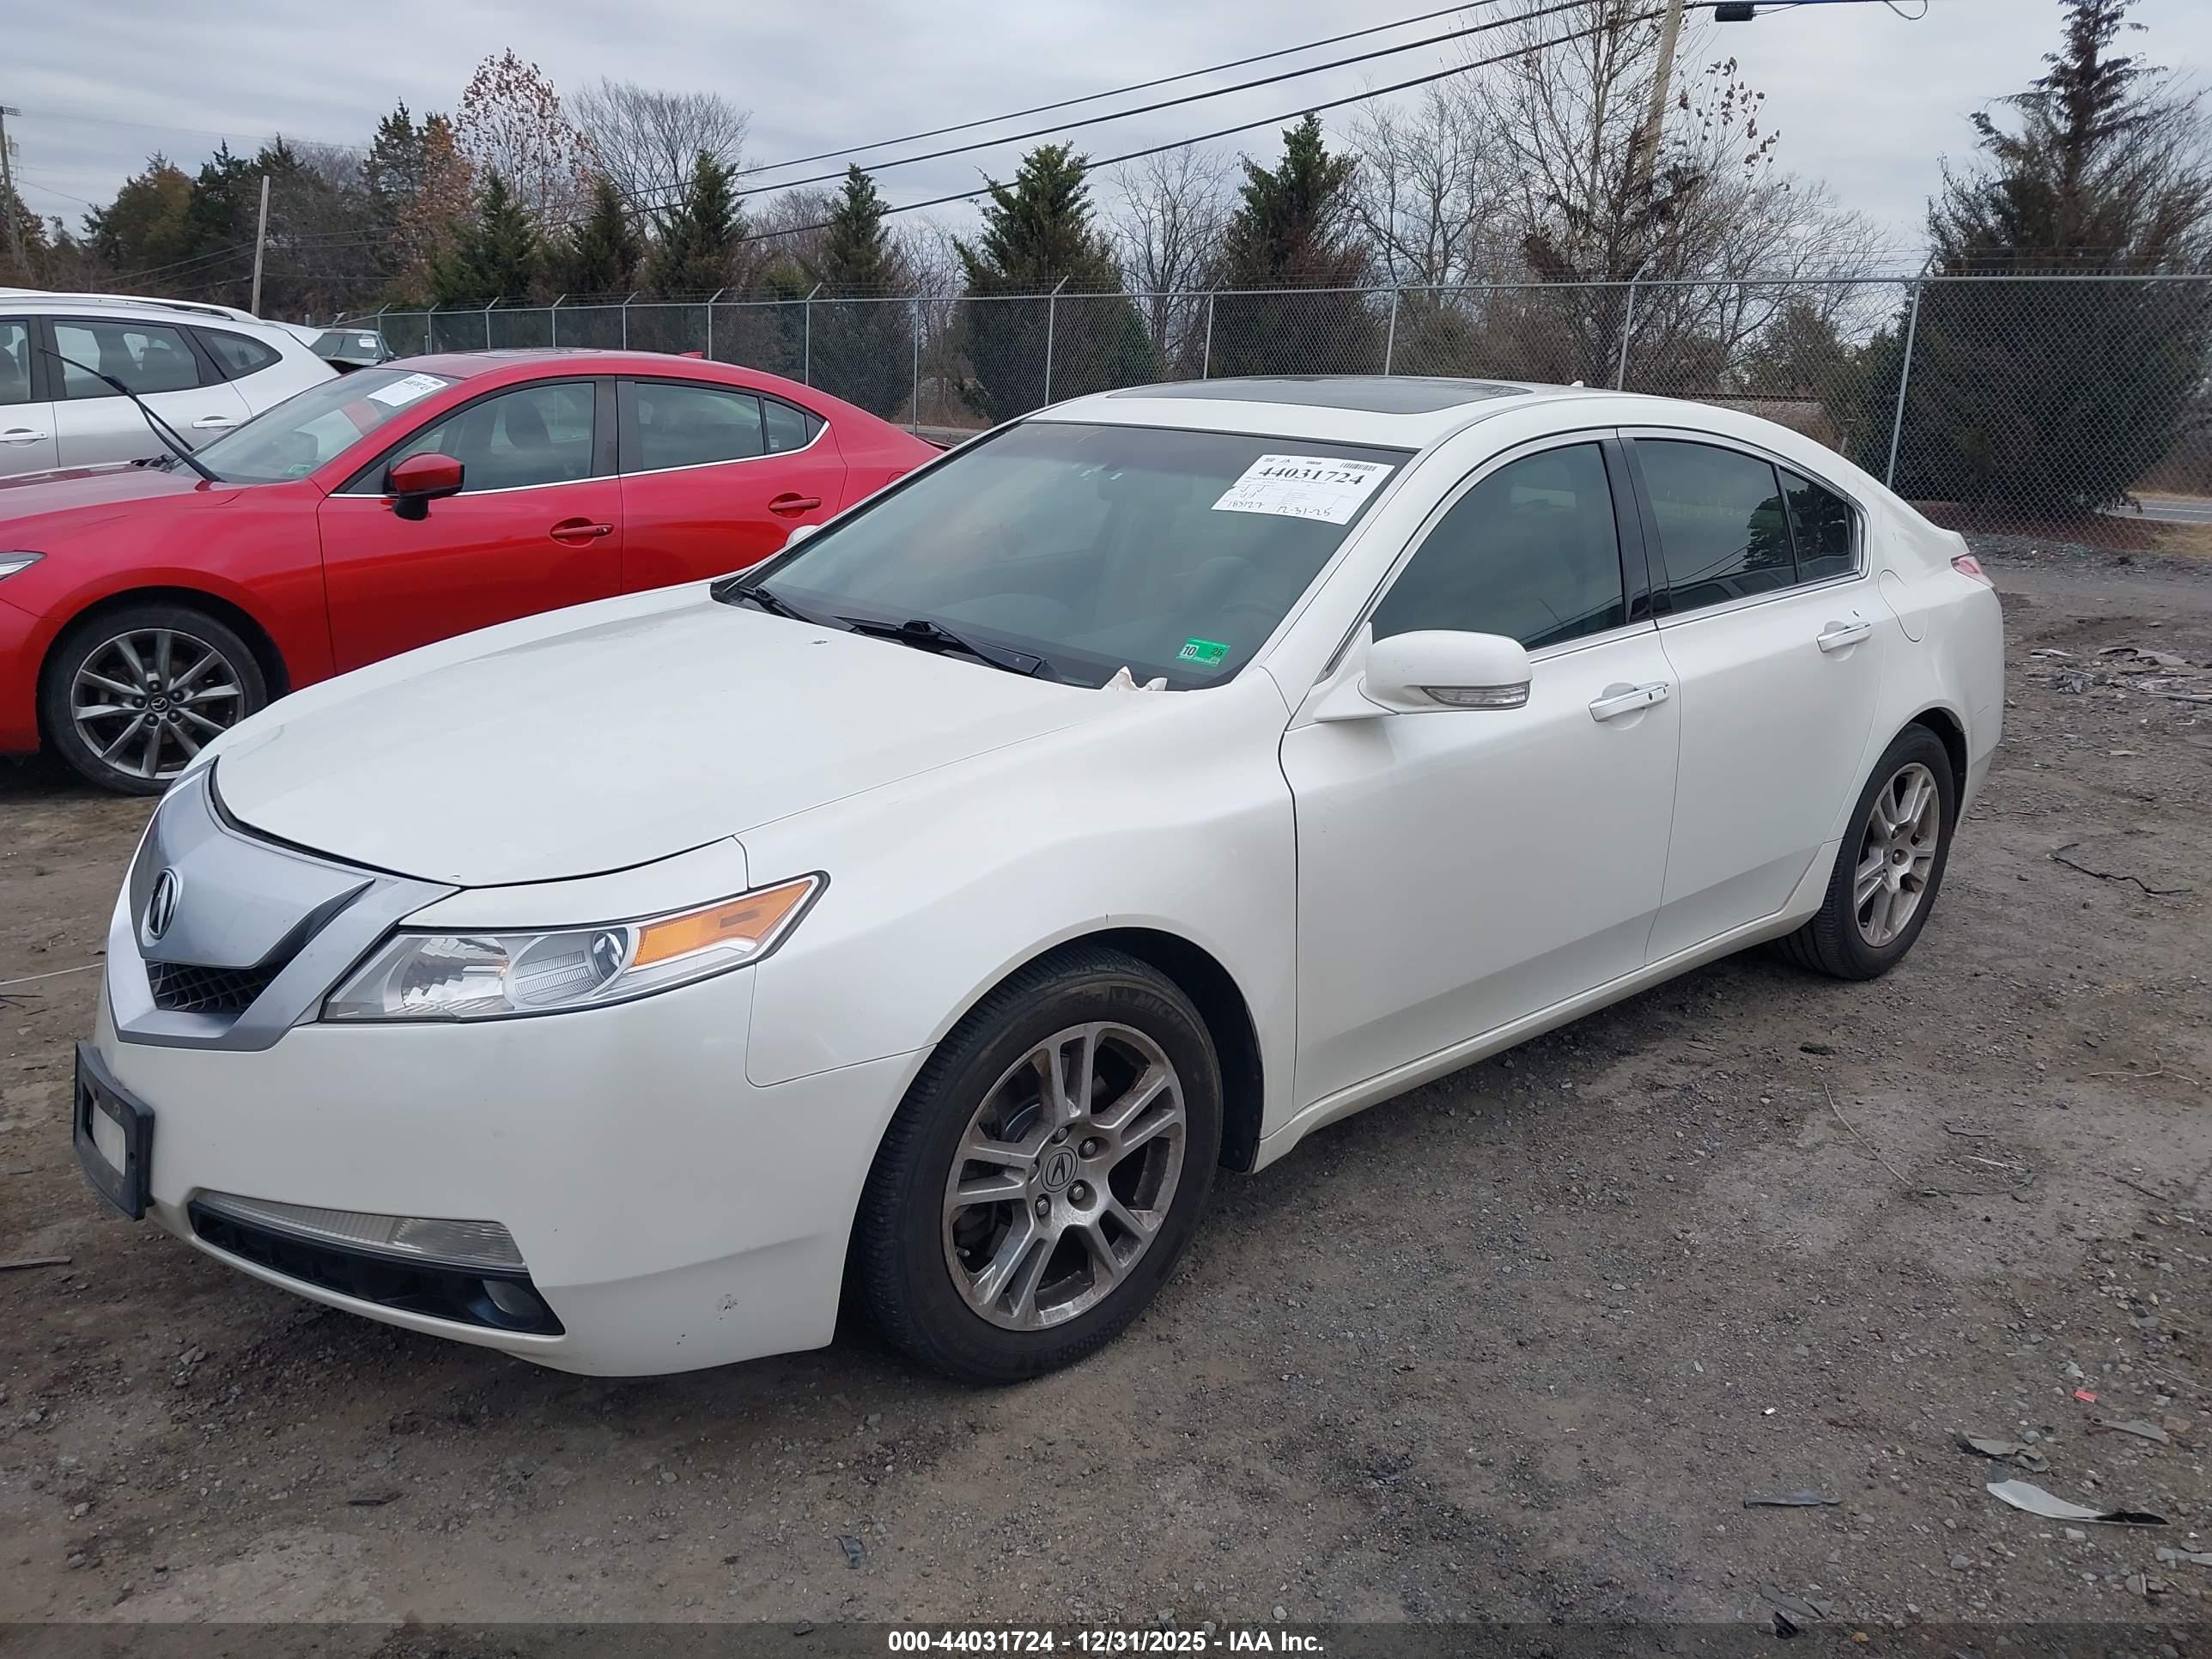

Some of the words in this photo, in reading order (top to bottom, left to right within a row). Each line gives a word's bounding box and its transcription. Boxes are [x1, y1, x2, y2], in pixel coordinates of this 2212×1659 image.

[1258, 466, 1366, 485] 44031724
[1276, 506, 1333, 517] 12-31-25
[1182, 646, 1197, 656] 10
